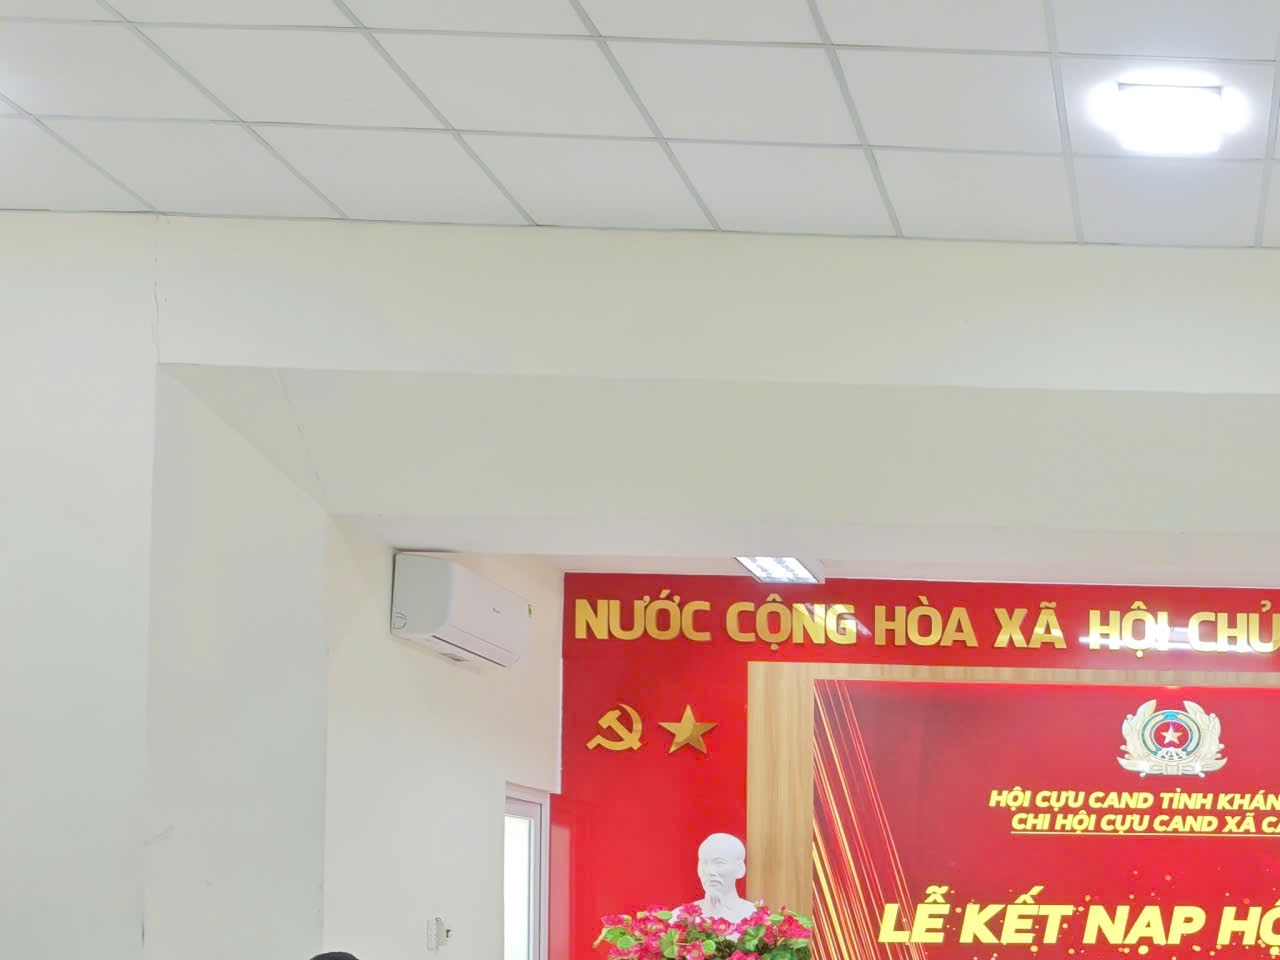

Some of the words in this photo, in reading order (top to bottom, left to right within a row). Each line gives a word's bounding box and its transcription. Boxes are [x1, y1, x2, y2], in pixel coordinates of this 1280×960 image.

[575, 589, 712, 642] NƯỚC
[726, 593, 857, 651] CỘNG
[874, 595, 978, 647] HÒA
[994, 601, 1067, 650] XÃ
[1088, 601, 1169, 657] HỘI
[989, 786, 1030, 809] HỘI
[1035, 790, 1084, 813] CỰU
[1088, 791, 1154, 809] CAND
[1160, 787, 1213, 810] TỈNH
[1010, 812, 1050, 831] CHI
[1054, 809, 1096, 833] HỘI
[1100, 813, 1150, 835] CỰU
[1153, 815, 1218, 832] CAND
[1221, 812, 1256, 833] XÃ
[878, 885, 950, 944] LỄ
[959, 885, 1074, 944] KẾT
[1082, 905, 1206, 955] NẠP
